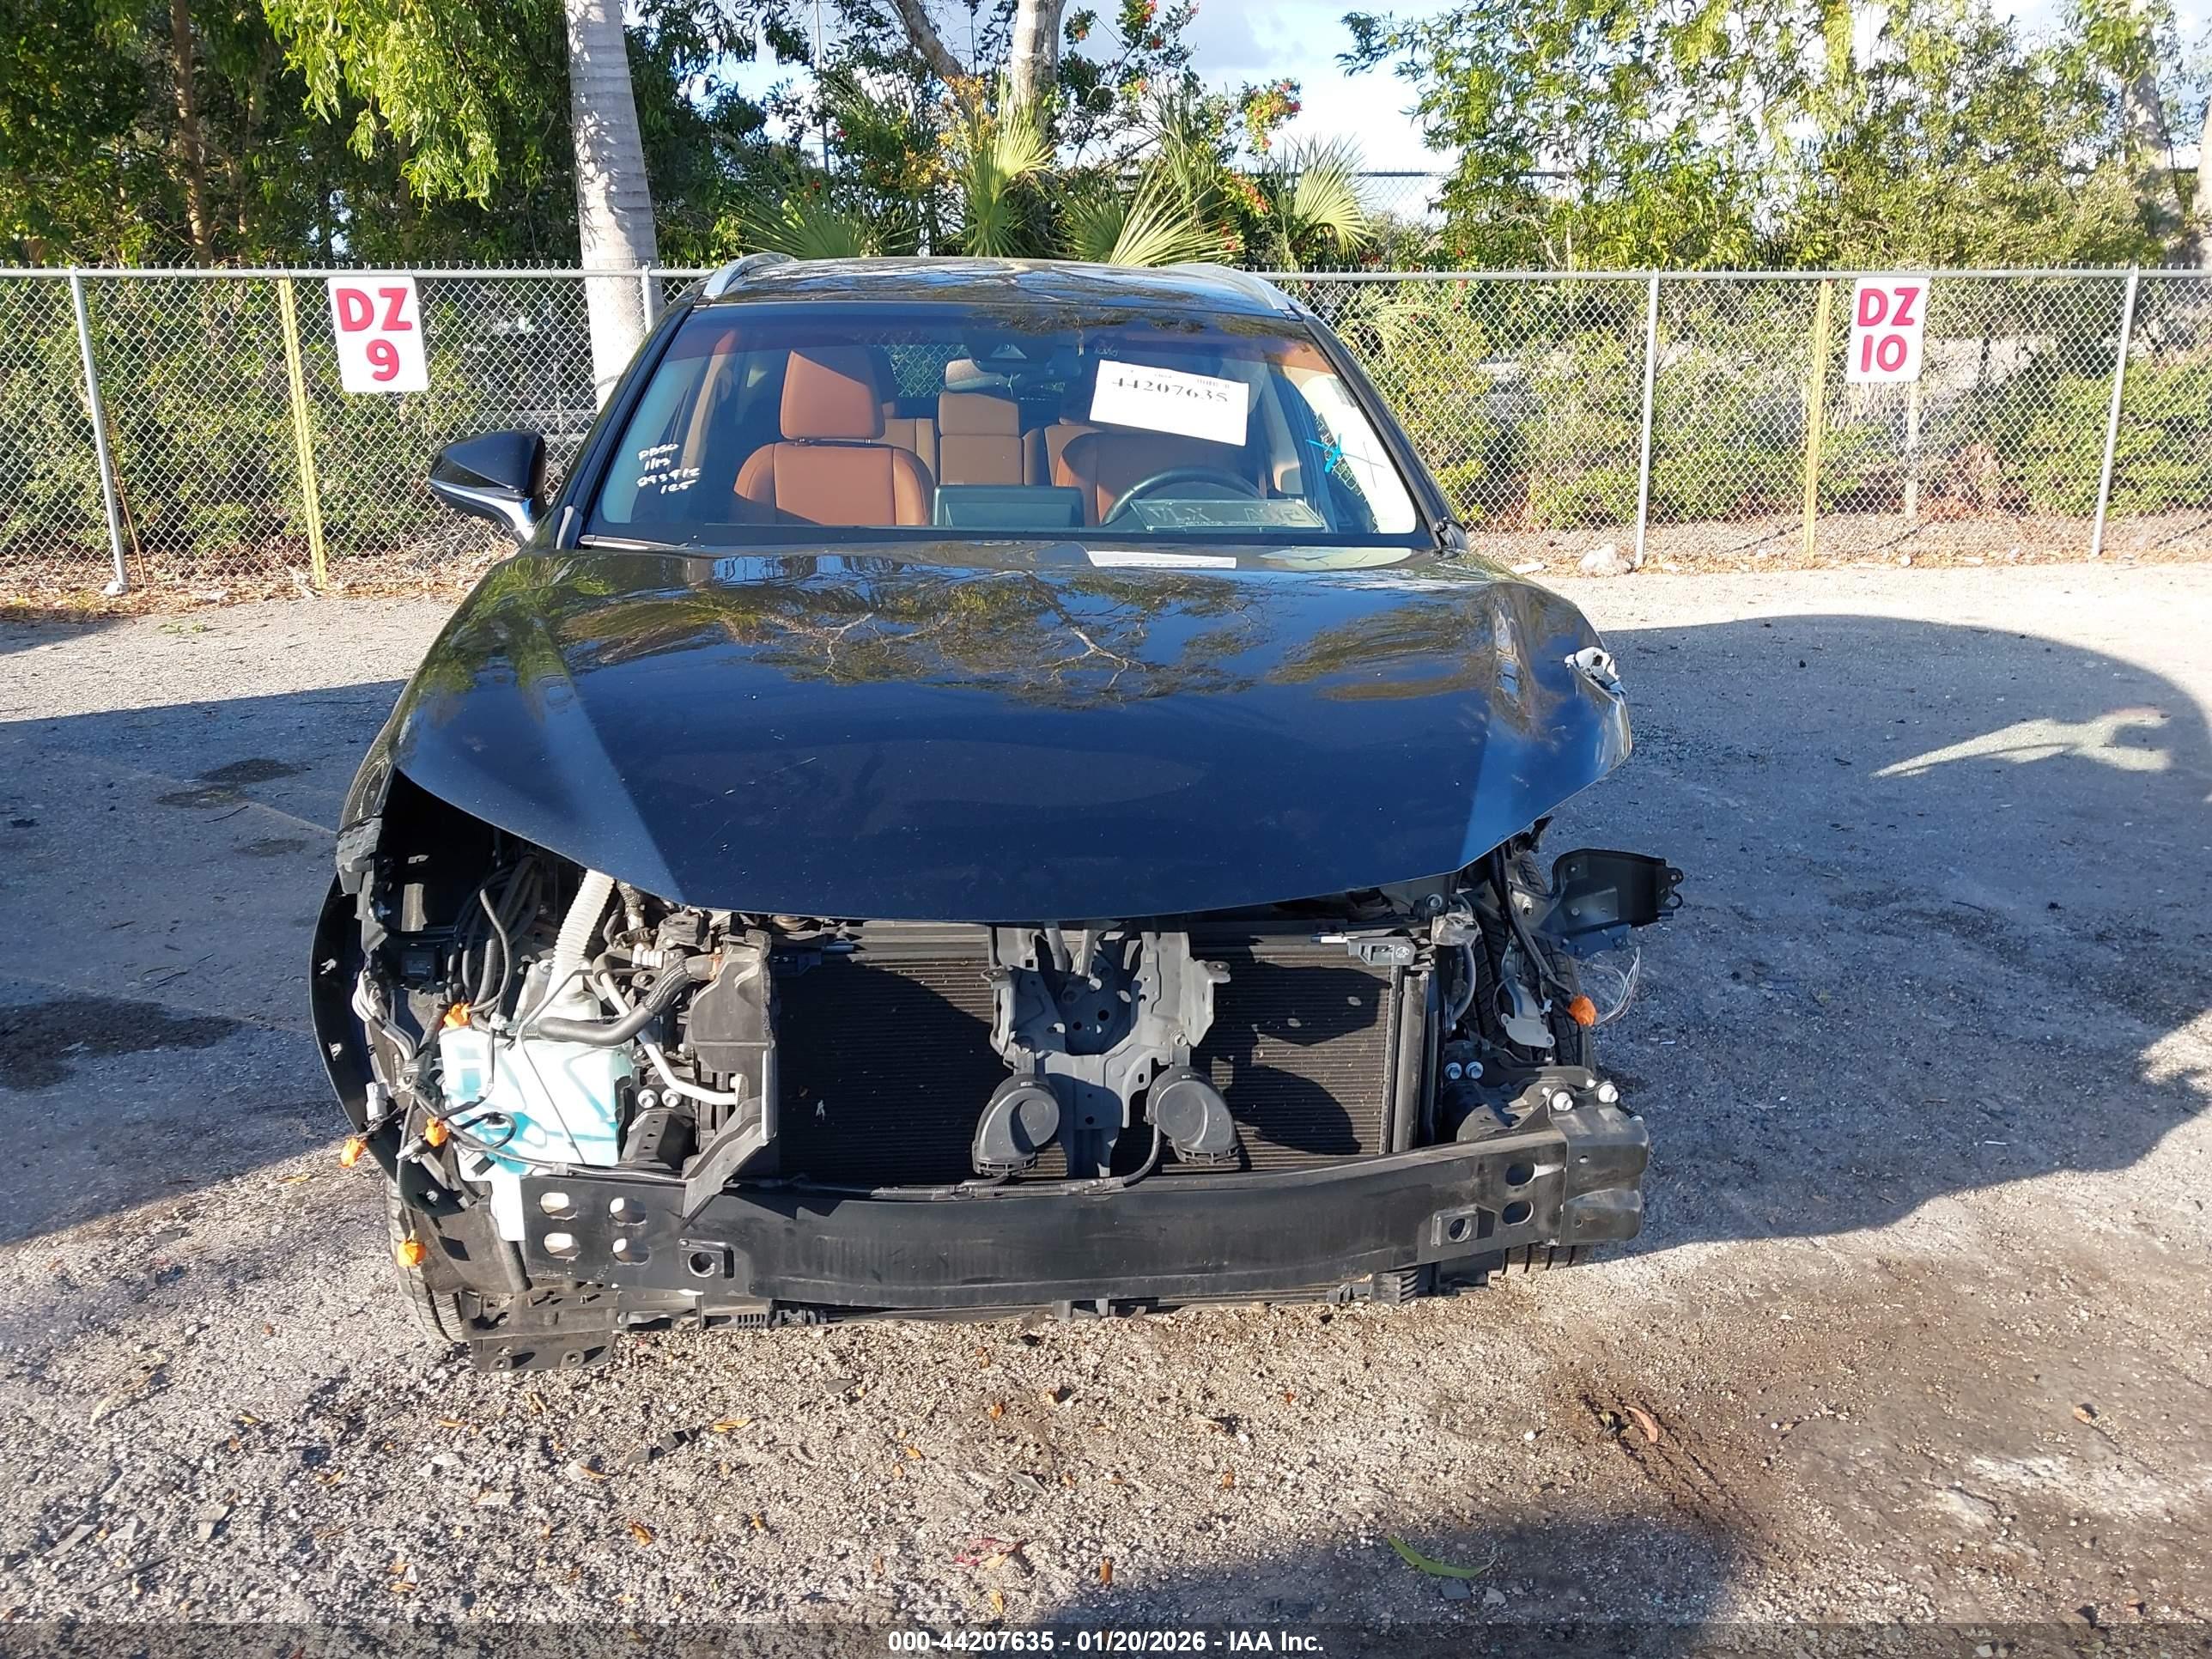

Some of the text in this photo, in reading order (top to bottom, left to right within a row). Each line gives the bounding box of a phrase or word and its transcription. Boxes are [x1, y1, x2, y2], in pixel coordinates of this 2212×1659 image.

[336, 288, 413, 332] DZ
[1857, 287, 1920, 327] DZ
[366, 338, 400, 382] 9
[1860, 334, 1908, 373] 10
